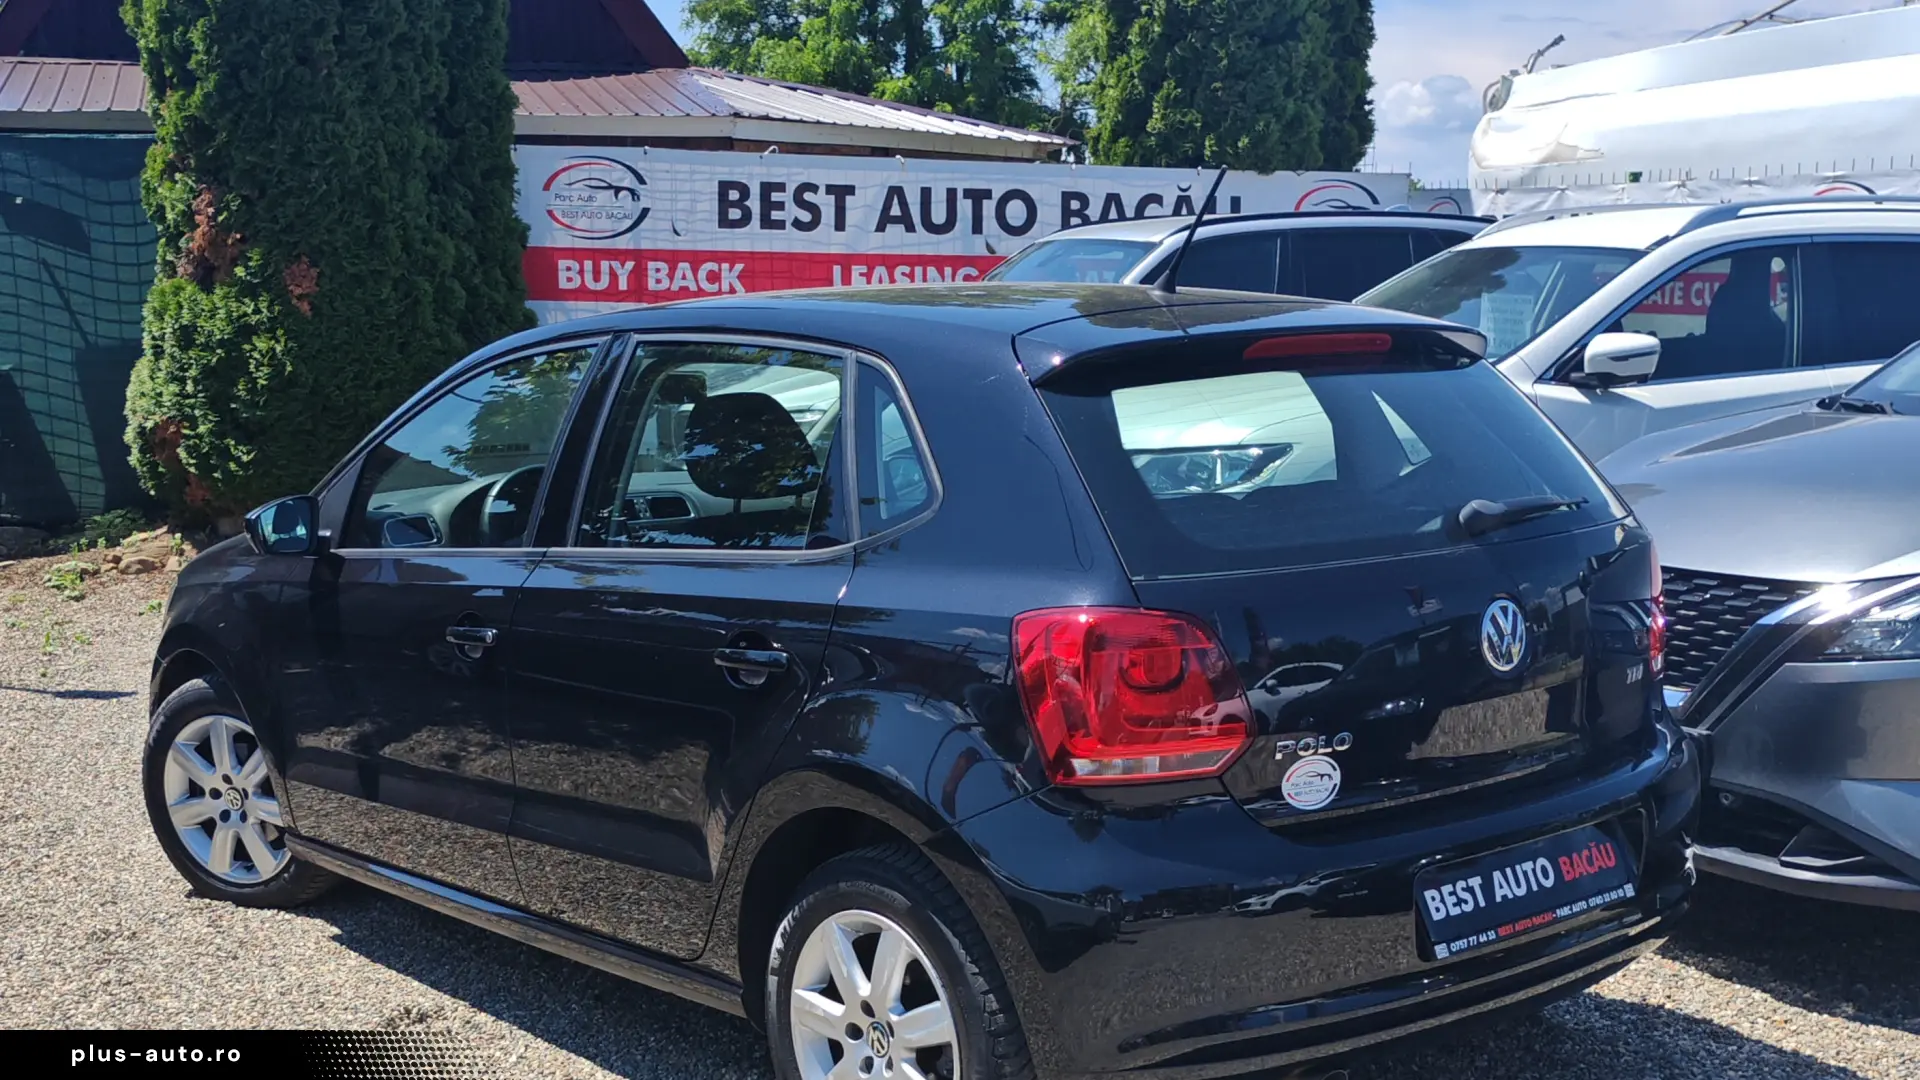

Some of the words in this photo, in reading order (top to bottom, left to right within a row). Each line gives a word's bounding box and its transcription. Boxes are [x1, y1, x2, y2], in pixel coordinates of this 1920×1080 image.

[554, 193, 575, 203] Parc
[576, 193, 598, 203] Auto
[717, 180, 856, 233] BEST
[874, 185, 1038, 237] AUTO
[561, 210, 579, 219] BEST
[580, 211, 603, 220] AUTO
[557, 259, 636, 291] BUY
[647, 261, 746, 294] BACK
[1275, 732, 1353, 760] POLO
[1423, 876, 1486, 922] BEST
[1492, 857, 1555, 903] AUTO
[1558, 842, 1617, 882] BACĂU
[1468, 936, 1477, 947] 77
